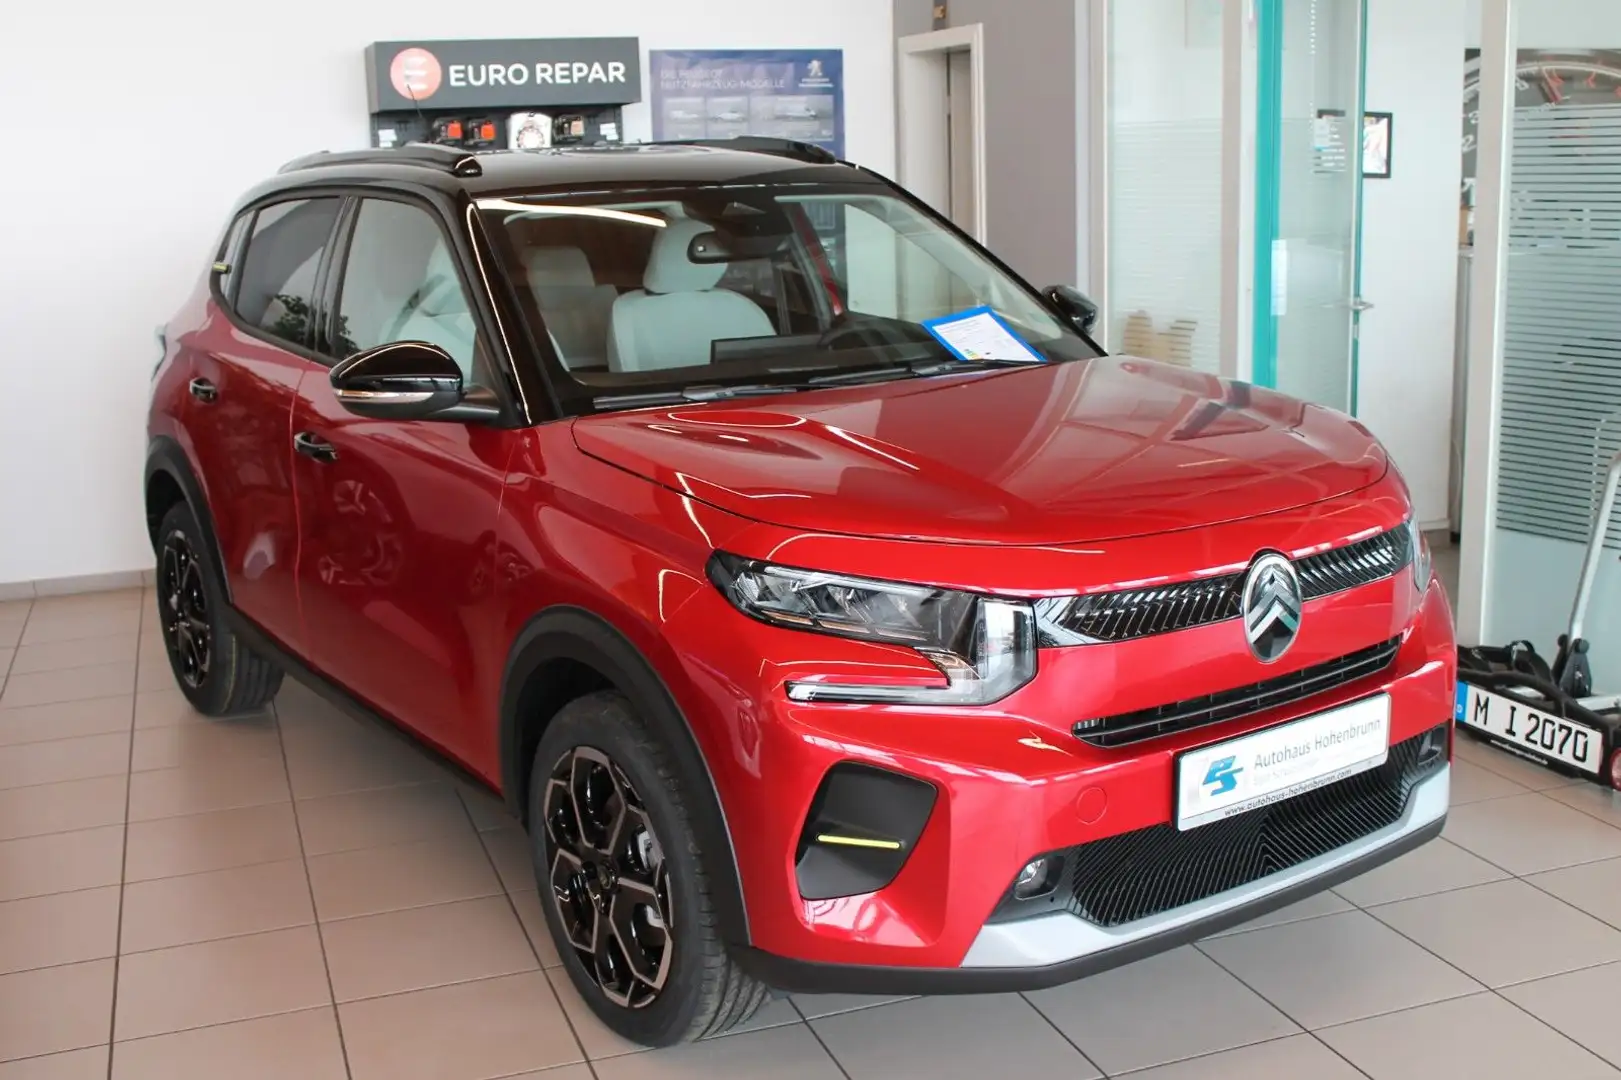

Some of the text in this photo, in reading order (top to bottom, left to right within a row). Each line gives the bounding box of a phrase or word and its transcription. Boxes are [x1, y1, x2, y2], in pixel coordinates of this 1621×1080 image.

[448, 61, 626, 87] EURO REPAR
[1253, 718, 1382, 770] Autohaus Hohenbrunn
[1474, 693, 1490, 726] M
[1505, 705, 1517, 737] I
[1525, 713, 1589, 763] 2070
[1224, 767, 1353, 817] www.autohaus-hohenbrunn.com
